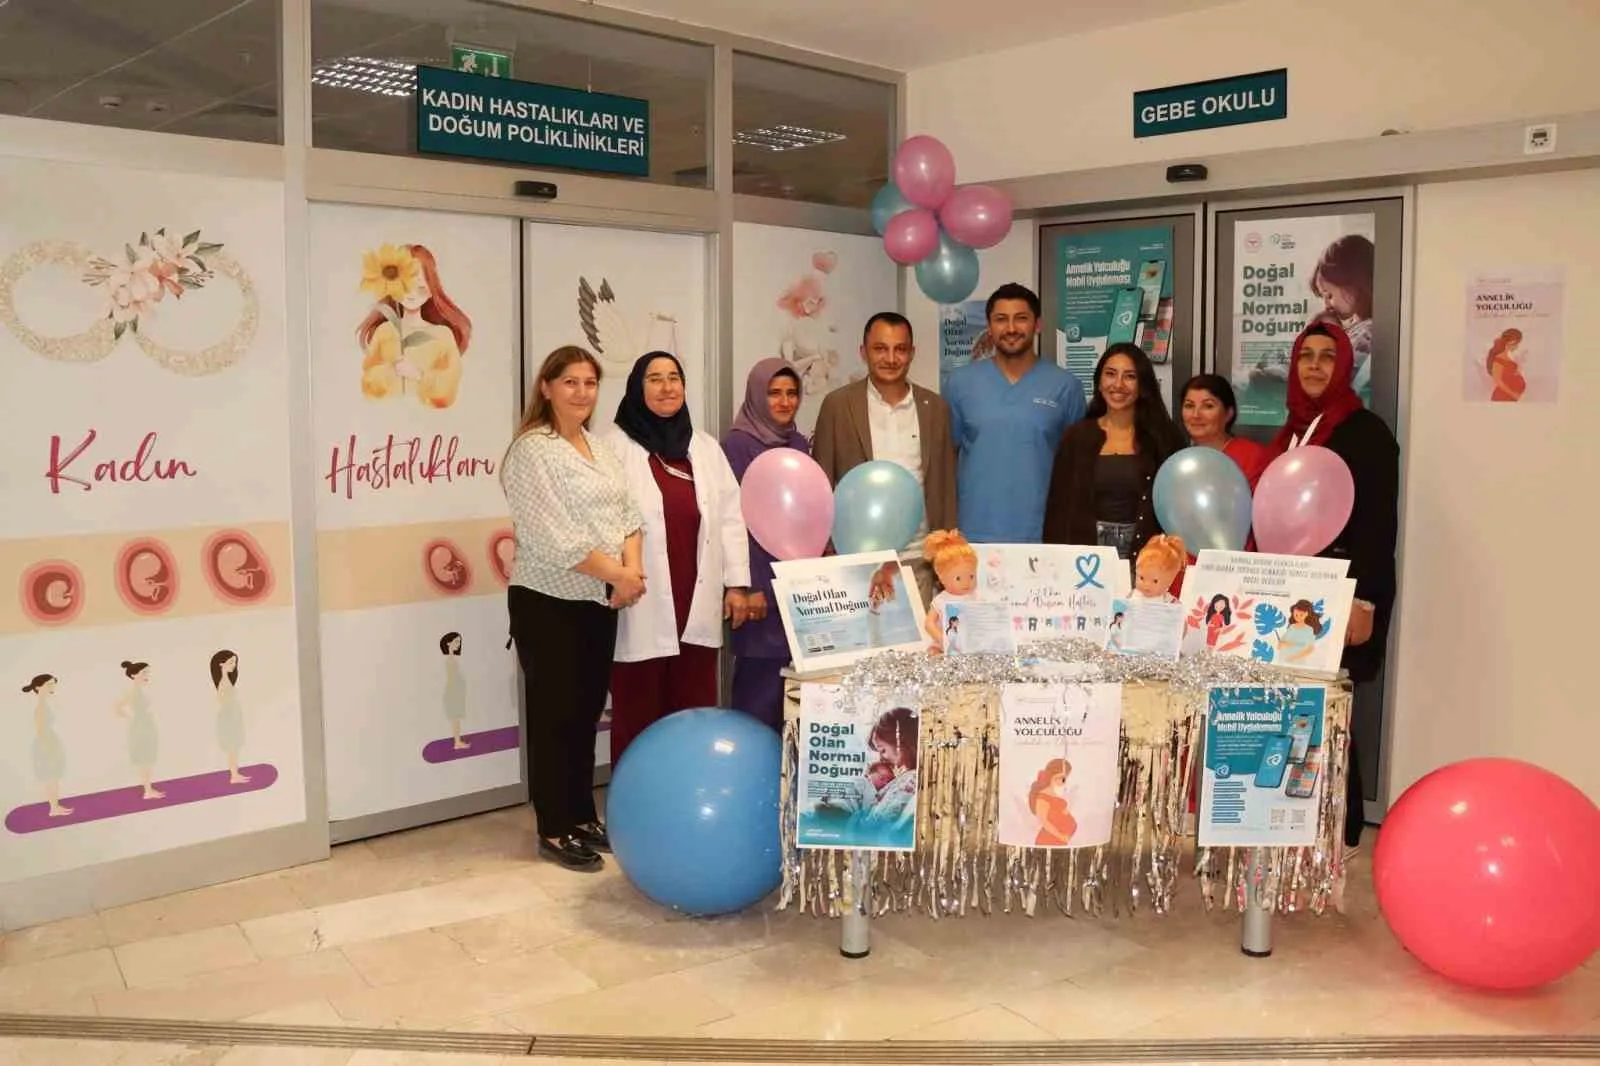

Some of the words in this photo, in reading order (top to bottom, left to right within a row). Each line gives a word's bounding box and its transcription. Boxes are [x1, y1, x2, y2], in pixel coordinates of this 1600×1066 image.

[422, 87, 483, 113] KADIN
[490, 98, 618, 131] HASTALIKLARI
[622, 117, 645, 134] VE
[1141, 100, 1196, 124] GEBE
[1202, 87, 1276, 115] OKULU
[429, 113, 501, 139] DOĞUM
[508, 124, 645, 157] POLİKLİNİKLERİ
[1242, 263, 1295, 282] Doğal
[1242, 283, 1284, 298] Olan
[1242, 299, 1308, 316] Normal
[45, 430, 196, 494] Kadın
[325, 434, 496, 499] Hastalıkları
[792, 589, 821, 605] Doğal
[824, 590, 847, 600] Olan
[796, 602, 834, 616] Normal
[835, 600, 869, 613] Doğum
[810, 722, 854, 737] Doğal
[810, 736, 845, 748] Olan
[809, 750, 866, 763] Normal
[809, 764, 863, 778] Doğum
